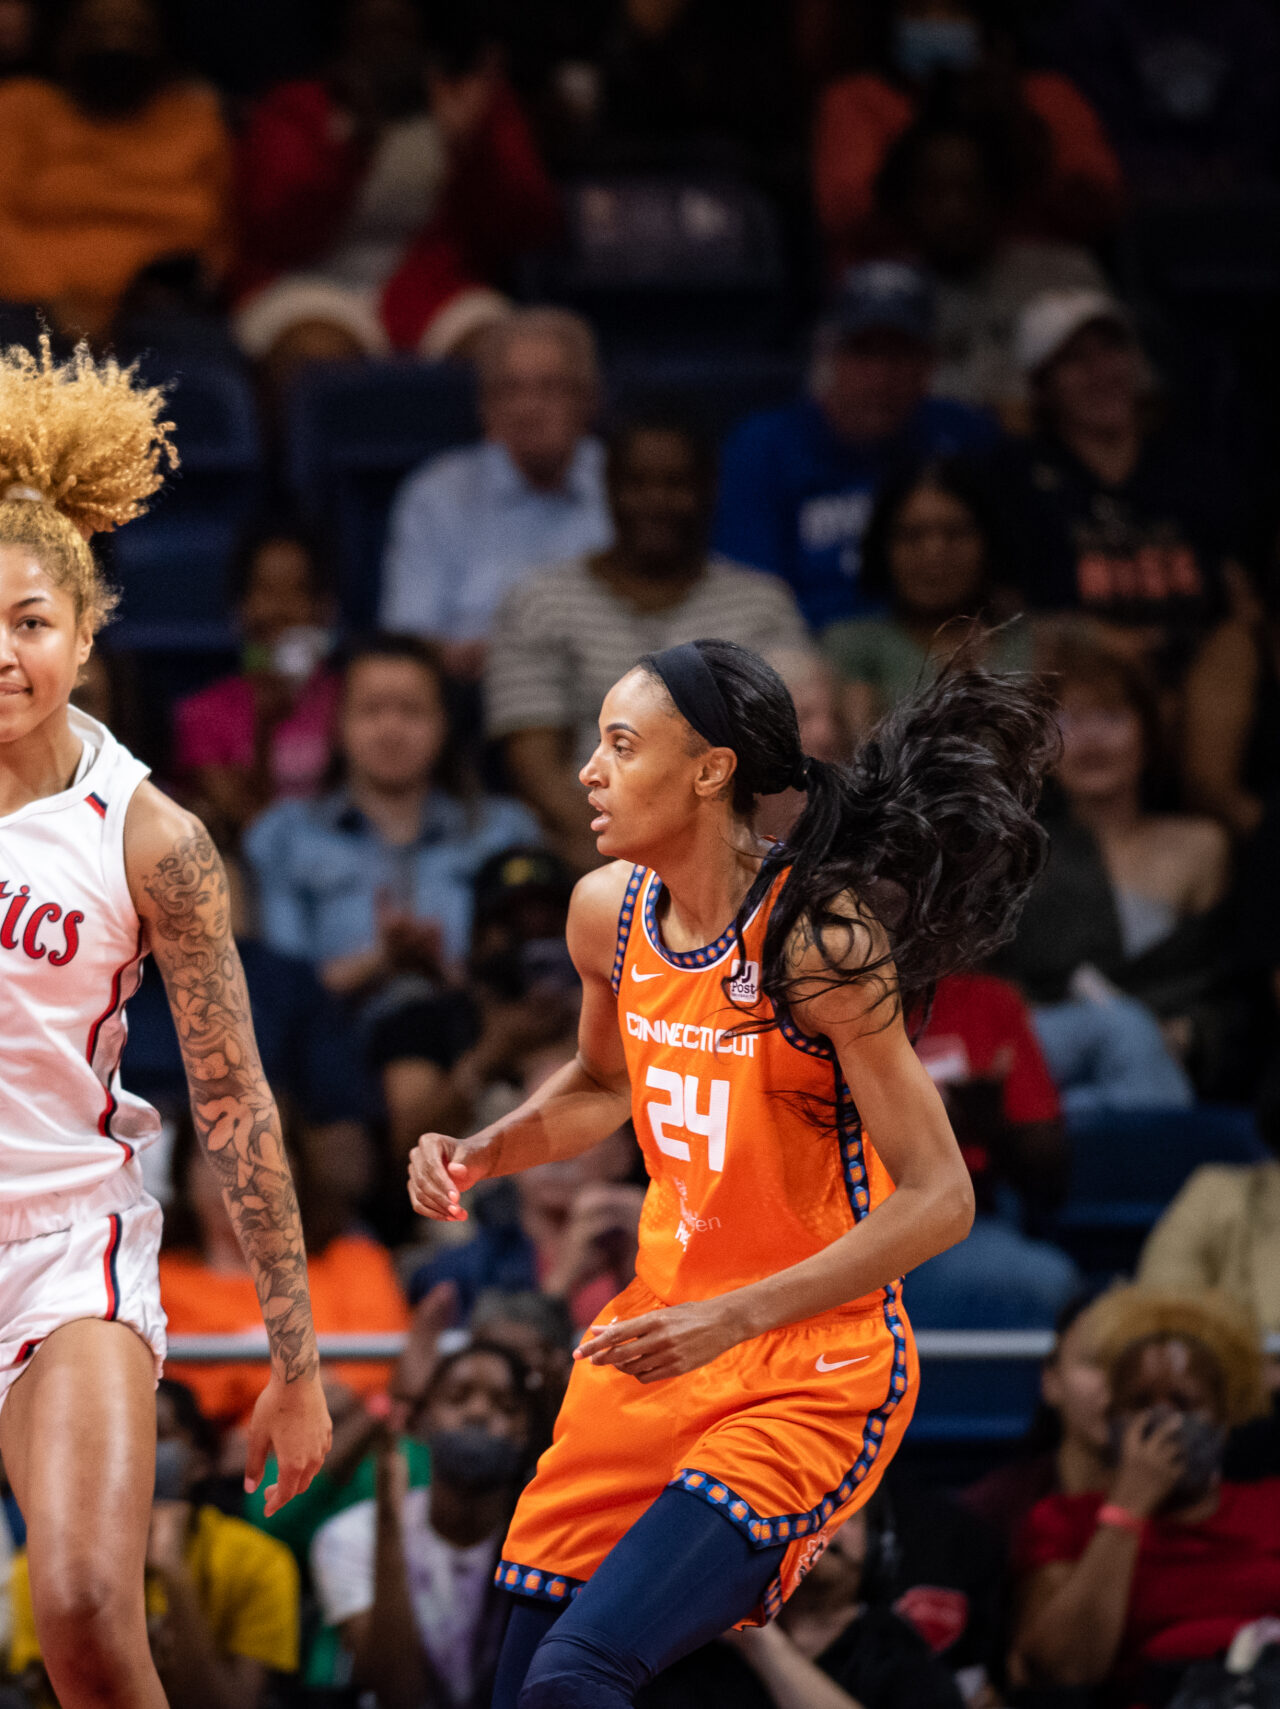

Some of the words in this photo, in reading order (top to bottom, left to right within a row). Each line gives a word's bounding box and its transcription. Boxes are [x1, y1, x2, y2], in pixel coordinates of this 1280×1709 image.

[731, 980, 756, 994] Post
[626, 1011, 759, 1058] CNNECTICUT
[646, 1066, 730, 1172] 24
